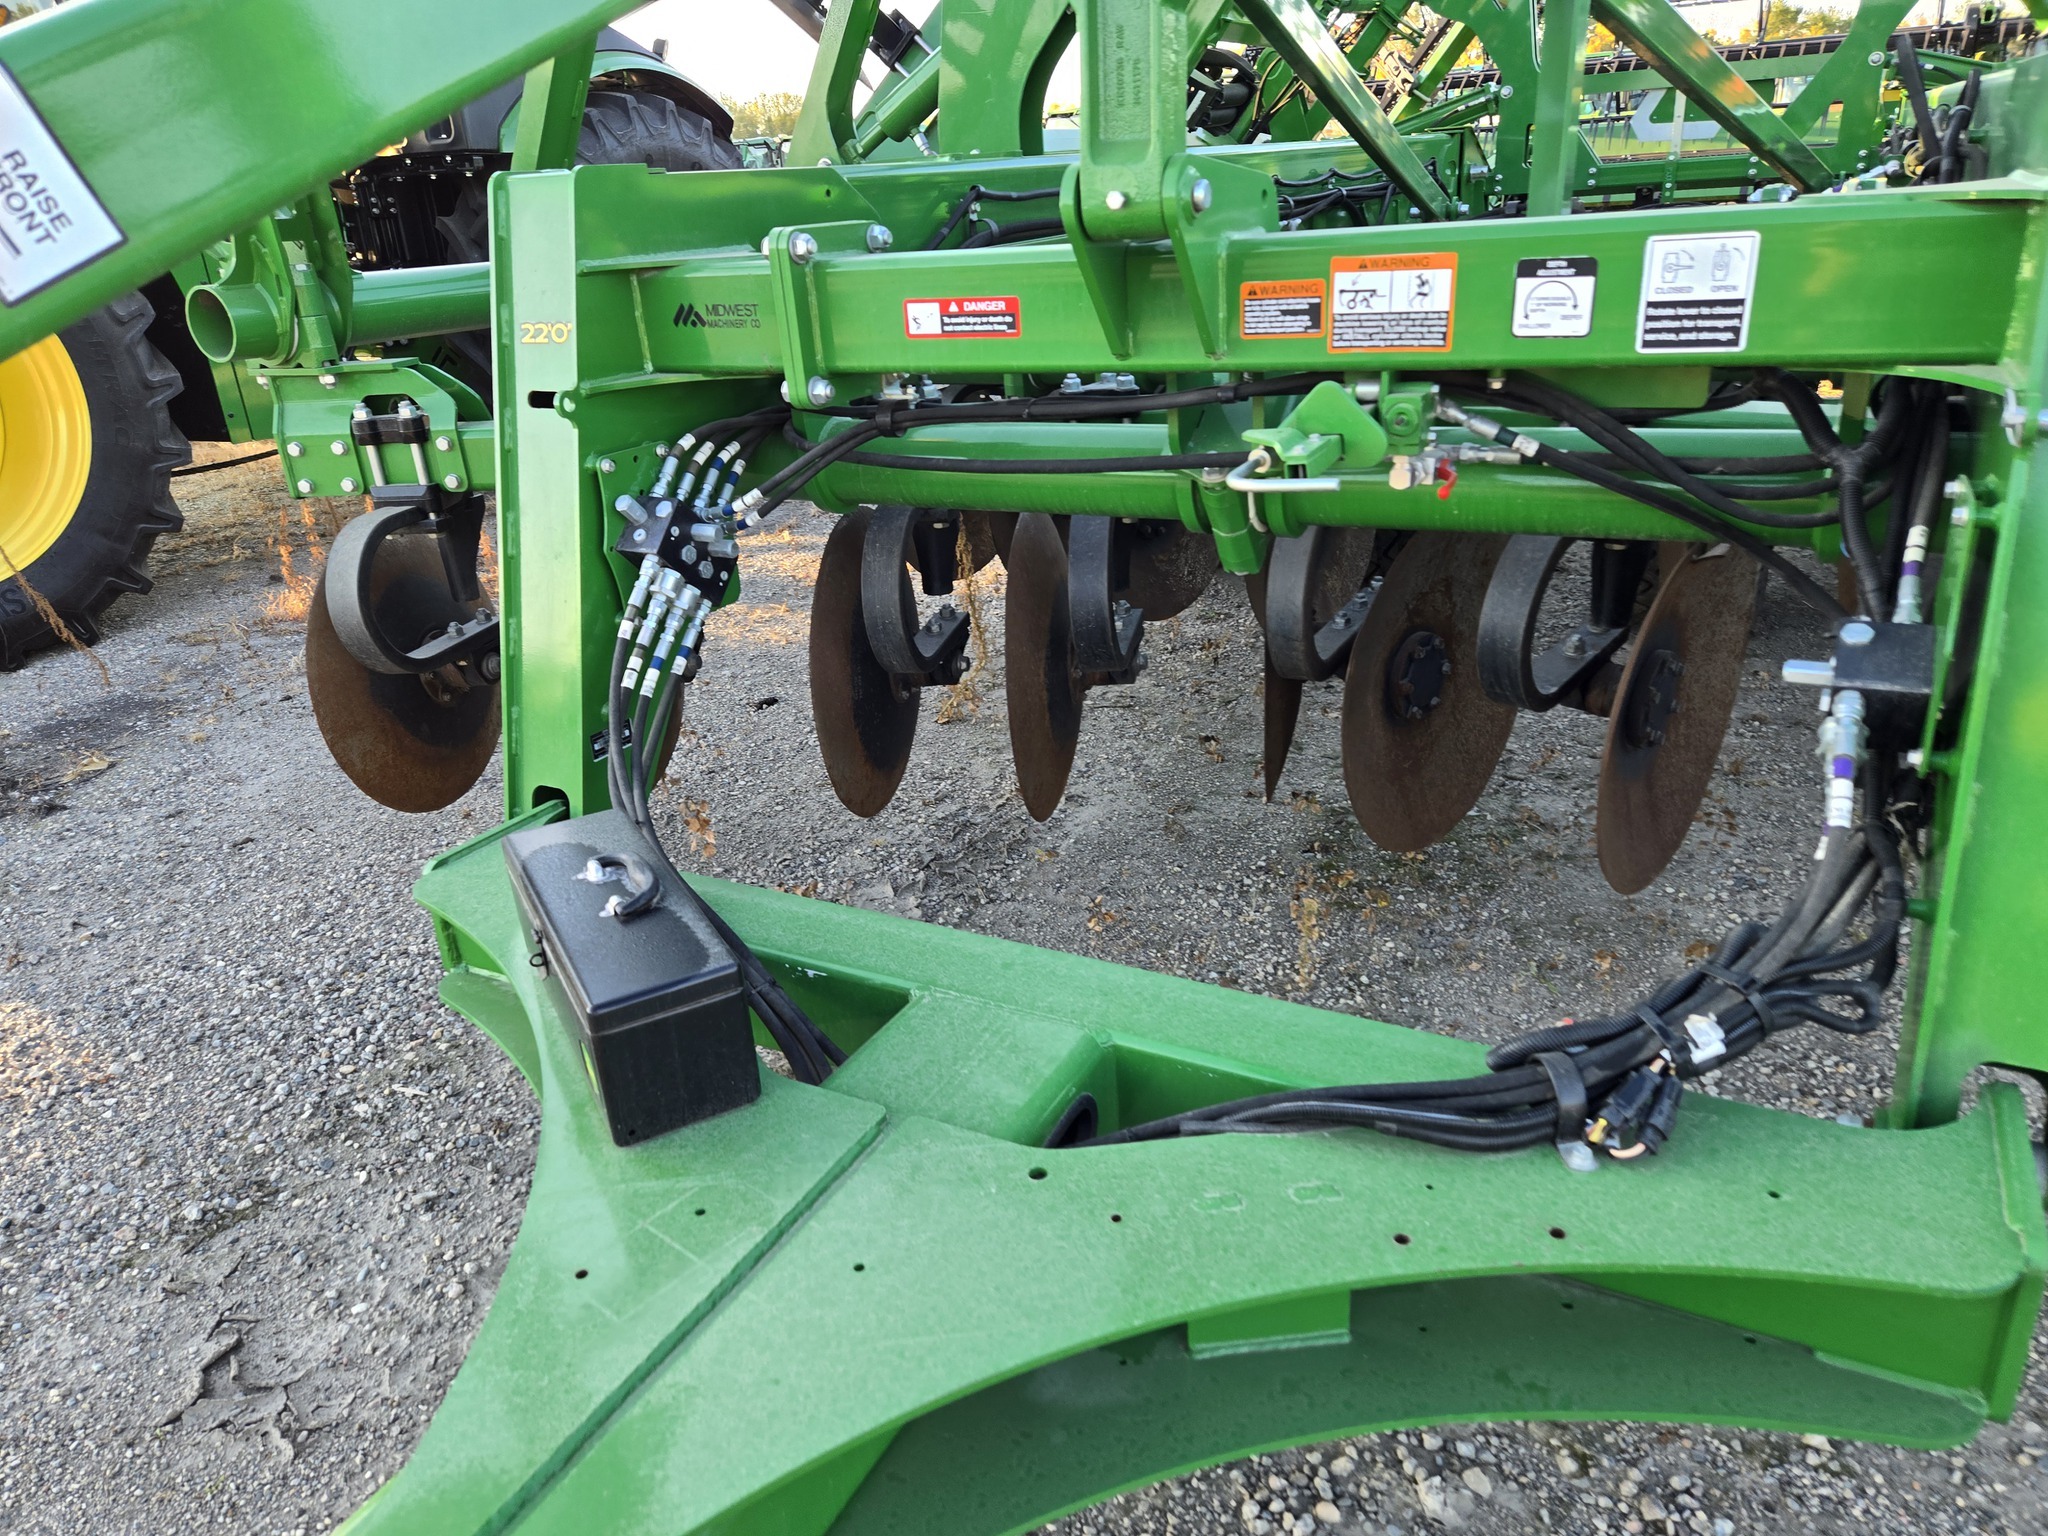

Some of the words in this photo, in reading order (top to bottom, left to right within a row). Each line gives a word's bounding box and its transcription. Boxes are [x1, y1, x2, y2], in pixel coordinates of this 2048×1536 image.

[3, 150, 73, 234] RAISE
[0, 172, 57, 244] RONT
[1369, 256, 1430, 269] WARNING
[1259, 283, 1319, 296] WARNING
[1654, 286, 1694, 294] CLOSED
[706, 304, 758, 317] MIDWEST
[963, 301, 1006, 312] DANGER
[707, 318, 748, 329] MACHINERY
[750, 318, 761, 328] CO
